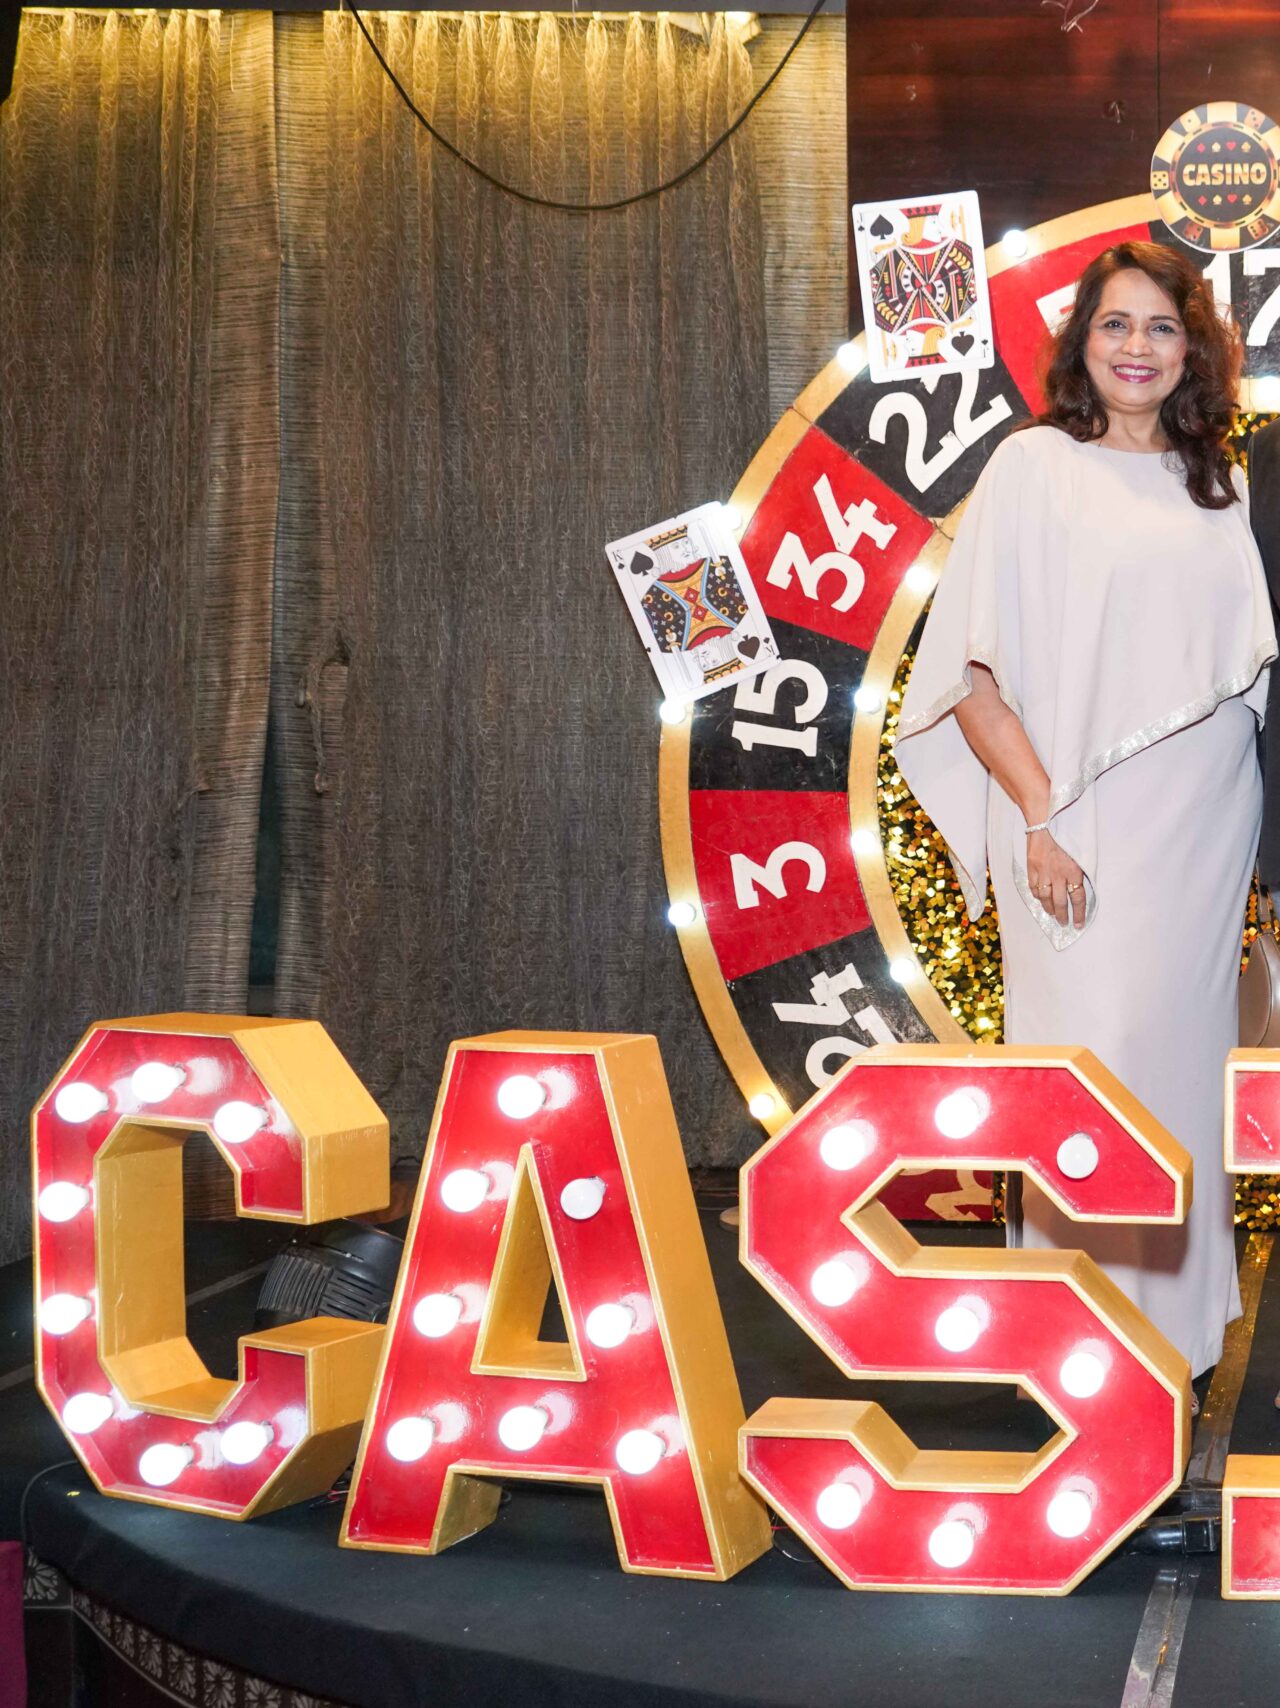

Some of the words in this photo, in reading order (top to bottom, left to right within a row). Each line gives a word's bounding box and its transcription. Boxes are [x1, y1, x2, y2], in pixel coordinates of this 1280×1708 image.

[1182, 162, 1267, 187] CASINO
[868, 368, 1013, 493] 22
[612, 550, 623, 562] K
[766, 473, 897, 612] 34
[731, 658, 829, 757] 15
[730, 841, 827, 909] 3
[771, 963, 898, 1087] 24
